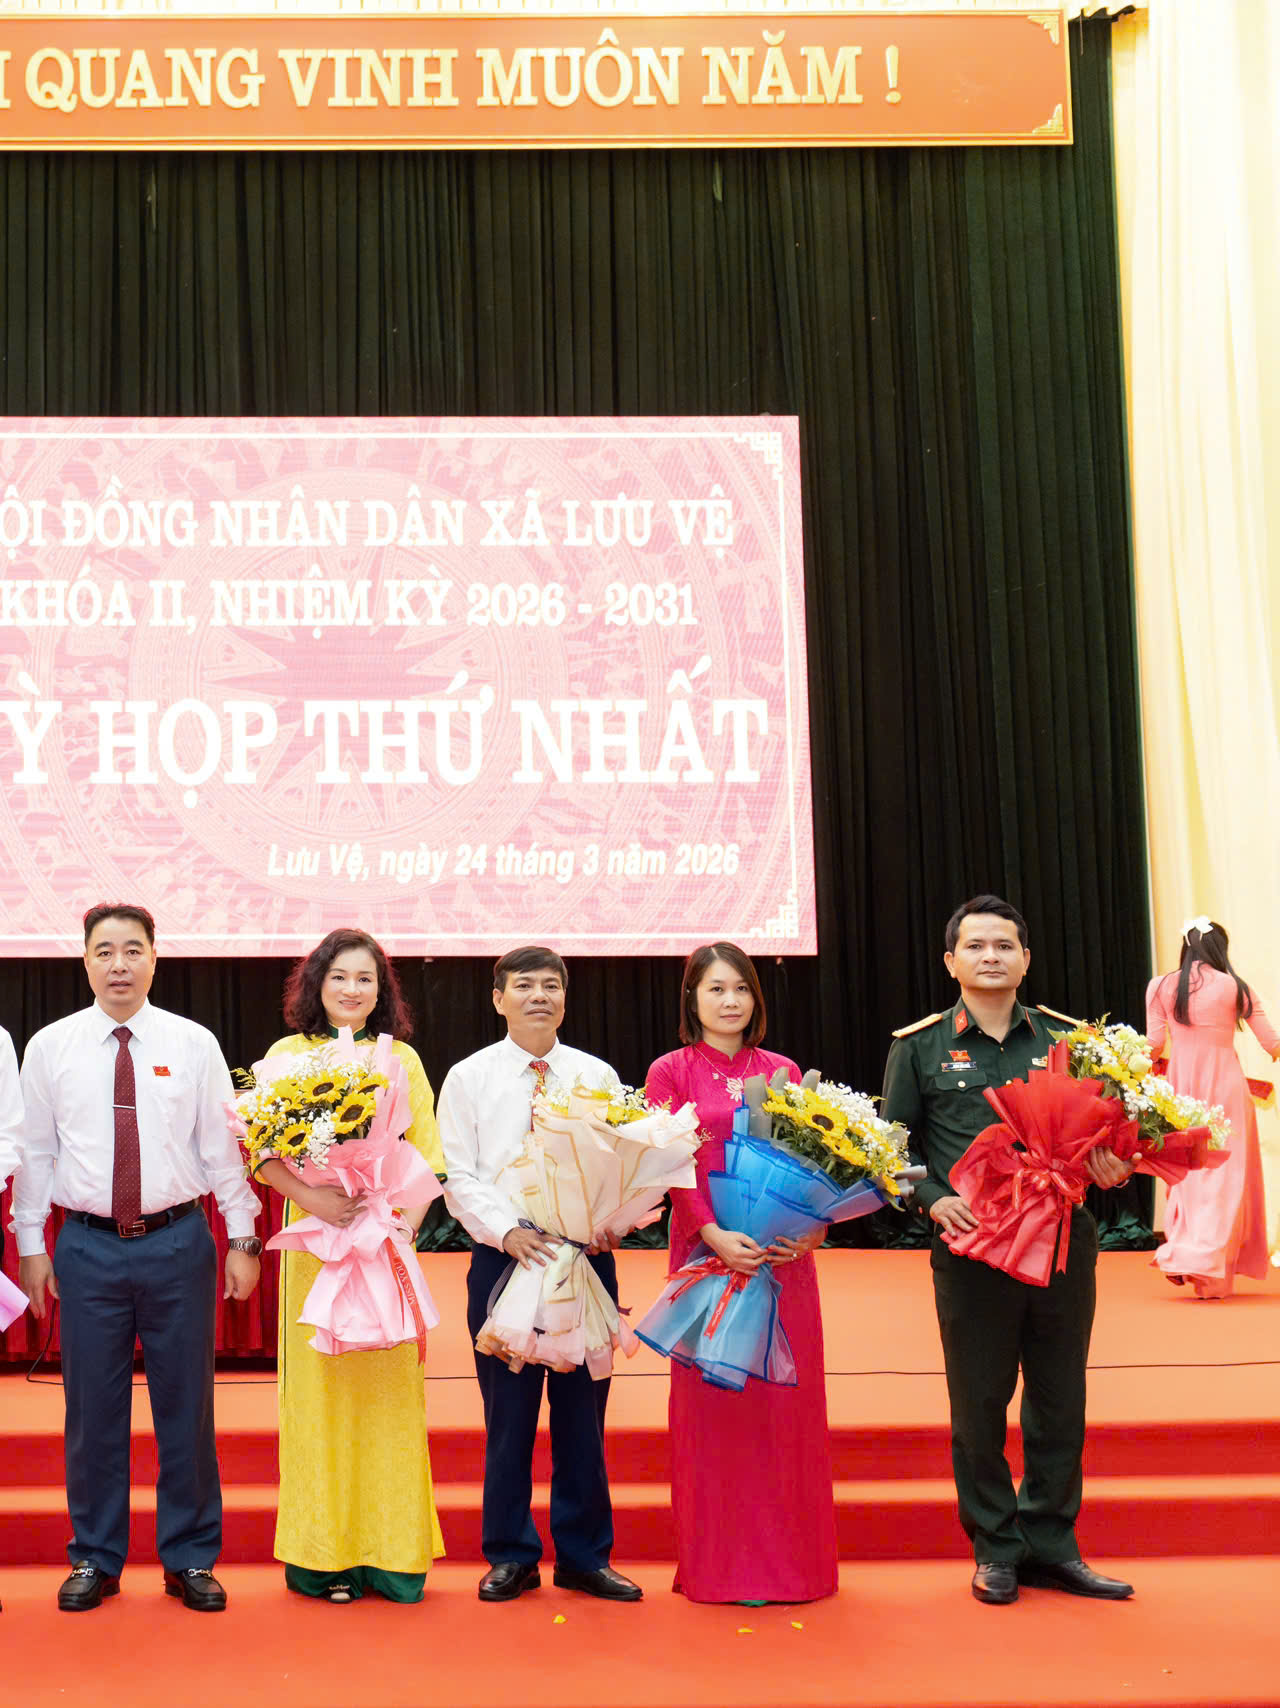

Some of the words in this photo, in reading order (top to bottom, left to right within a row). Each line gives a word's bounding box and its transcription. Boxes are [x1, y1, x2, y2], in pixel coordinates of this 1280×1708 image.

[25, 47, 266, 113] QUANG
[277, 47, 460, 107] VINH
[475, 27, 685, 107] MUÔN
[701, 29, 863, 105] NĂM
[884, 44, 903, 103] !
[61, 475, 199, 548] ĐỒNG
[210, 484, 350, 547] NHÂN
[363, 484, 467, 547] DÂN
[479, 488, 550, 546] XÃ
[562, 492, 654, 547] LƯU
[668, 484, 733, 559] VỆ
[149, 580, 197, 635] II,
[210, 563, 373, 640] NHIỆM
[383, 564, 453, 626] KỲ
[466, 582, 566, 627] 2026
[604, 582, 698, 626] 2031
[90, 698, 278, 809] HỌP
[303, 670, 495, 786] THỨ
[511, 655, 769, 784] NHẤT
[267, 844, 321, 876] Lưu
[328, 843, 370, 883] Vệ,
[380, 842, 449, 884] ngày
[454, 844, 487, 875] 24
[495, 841, 575, 884] tháng
[582, 844, 599, 876] 3
[607, 843, 667, 875] năm
[674, 843, 740, 875] 2026
[395, 1262, 408, 1282] YOU
[404, 1282, 417, 1305] MISS
